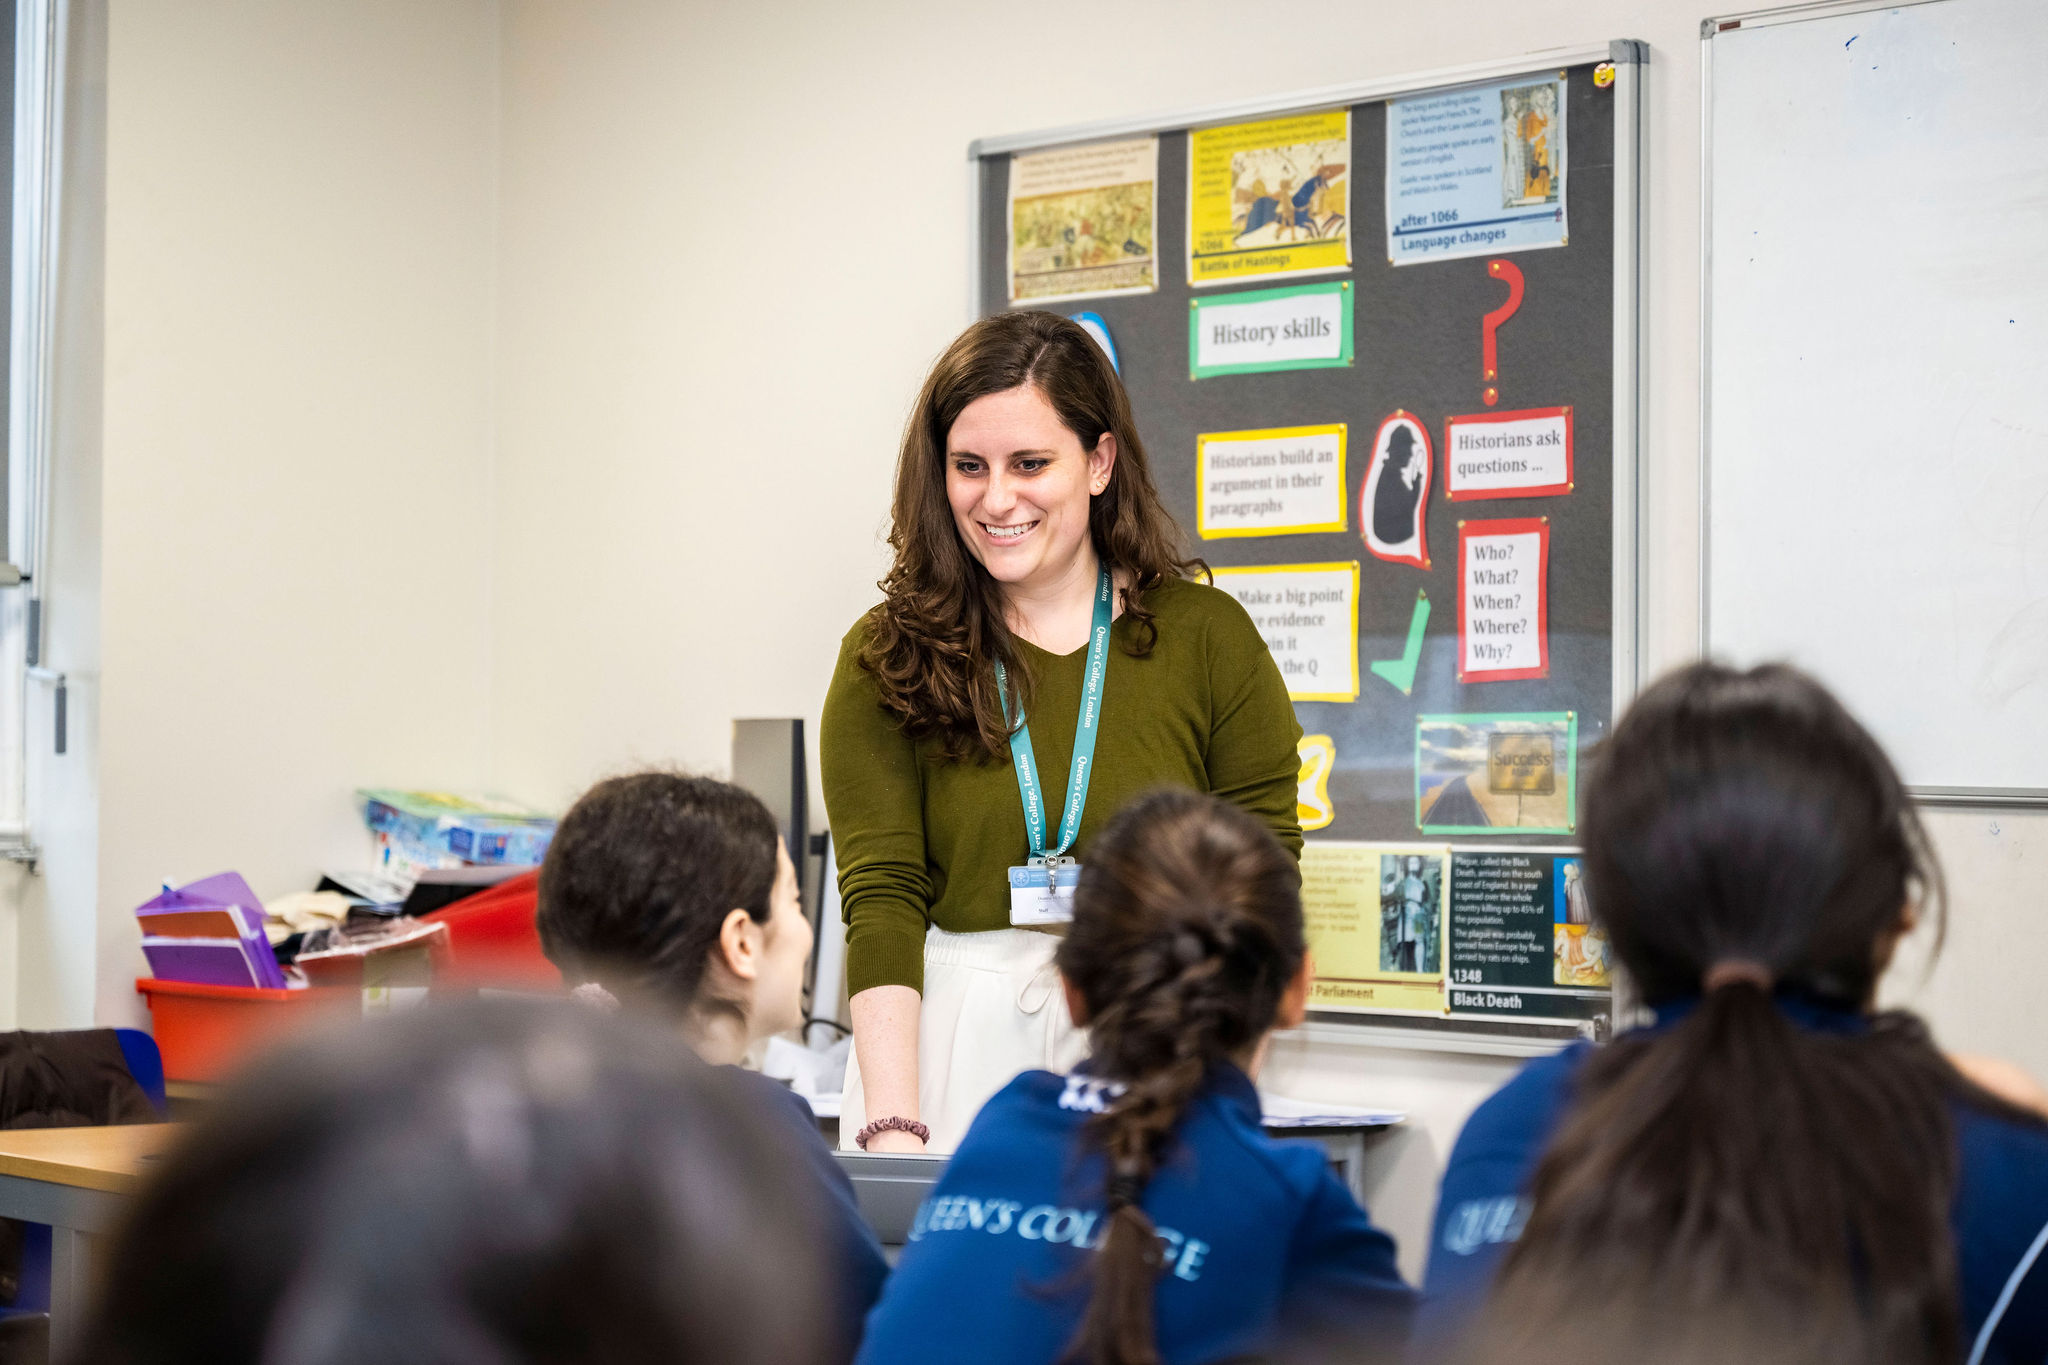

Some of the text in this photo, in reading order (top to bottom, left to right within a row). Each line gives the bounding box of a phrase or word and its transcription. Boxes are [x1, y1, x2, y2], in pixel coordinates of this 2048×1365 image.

[1402, 209, 1458, 228] after 1066
[1402, 229, 1507, 252] Language changes
[1200, 253, 1290, 273] Battle of Hastings
[1213, 316, 1332, 346] History skills
[1457, 429, 1561, 451] Historians ask
[1210, 448, 1333, 470] Historians build an
[1457, 457, 1528, 479] questions
[1209, 472, 1325, 496] argument in their
[1209, 498, 1284, 520] paragraphs
[1474, 543, 1515, 561] Who?
[1473, 568, 1519, 586] What?
[1101, 572, 1111, 602] London
[1238, 586, 1344, 607] Make a big point
[1472, 593, 1522, 611] When?
[1267, 611, 1326, 628] evidence
[1472, 617, 1528, 635] Where?
[1287, 636, 1298, 651] it
[1473, 643, 1513, 665] Why?
[1283, 658, 1305, 674] the
[1307, 658, 1319, 678] Q
[1084, 626, 1107, 729] Queen's College, London
[1020, 753, 1033, 787] London
[1074, 755, 1088, 792] Queen's
[1028, 788, 1039, 825] College,
[1066, 792, 1082, 828] College,
[1501, 857, 1512, 866] the
[1512, 857, 1530, 867] Black
[1502, 870, 1511, 878] on
[1512, 869, 1522, 879] the
[1523, 870, 1543, 879] south
[1524, 883, 1538, 892] year
[1461, 892, 1484, 903] spread
[1484, 893, 1499, 902] over
[1500, 893, 1511, 901] the
[1512, 893, 1533, 903] whole
[1455, 904, 1481, 914] country
[1481, 904, 1502, 915] killing
[1502, 905, 1512, 915] up
[1512, 905, 1521, 914] to
[1536, 904, 1545, 915] of
[1454, 915, 1466, 924] the
[1454, 928, 1467, 937] The
[1468, 929, 1490, 941] plague
[1506, 930, 1536, 943] probably
[1519, 943, 1528, 953] by
[1478, 953, 1487, 964] by
[1488, 954, 1500, 962] rats
[1501, 955, 1511, 963] on
[1454, 968, 1483, 984] 1348
[1315, 984, 1375, 1000] Parliament
[1453, 992, 1523, 1009] Black Death
